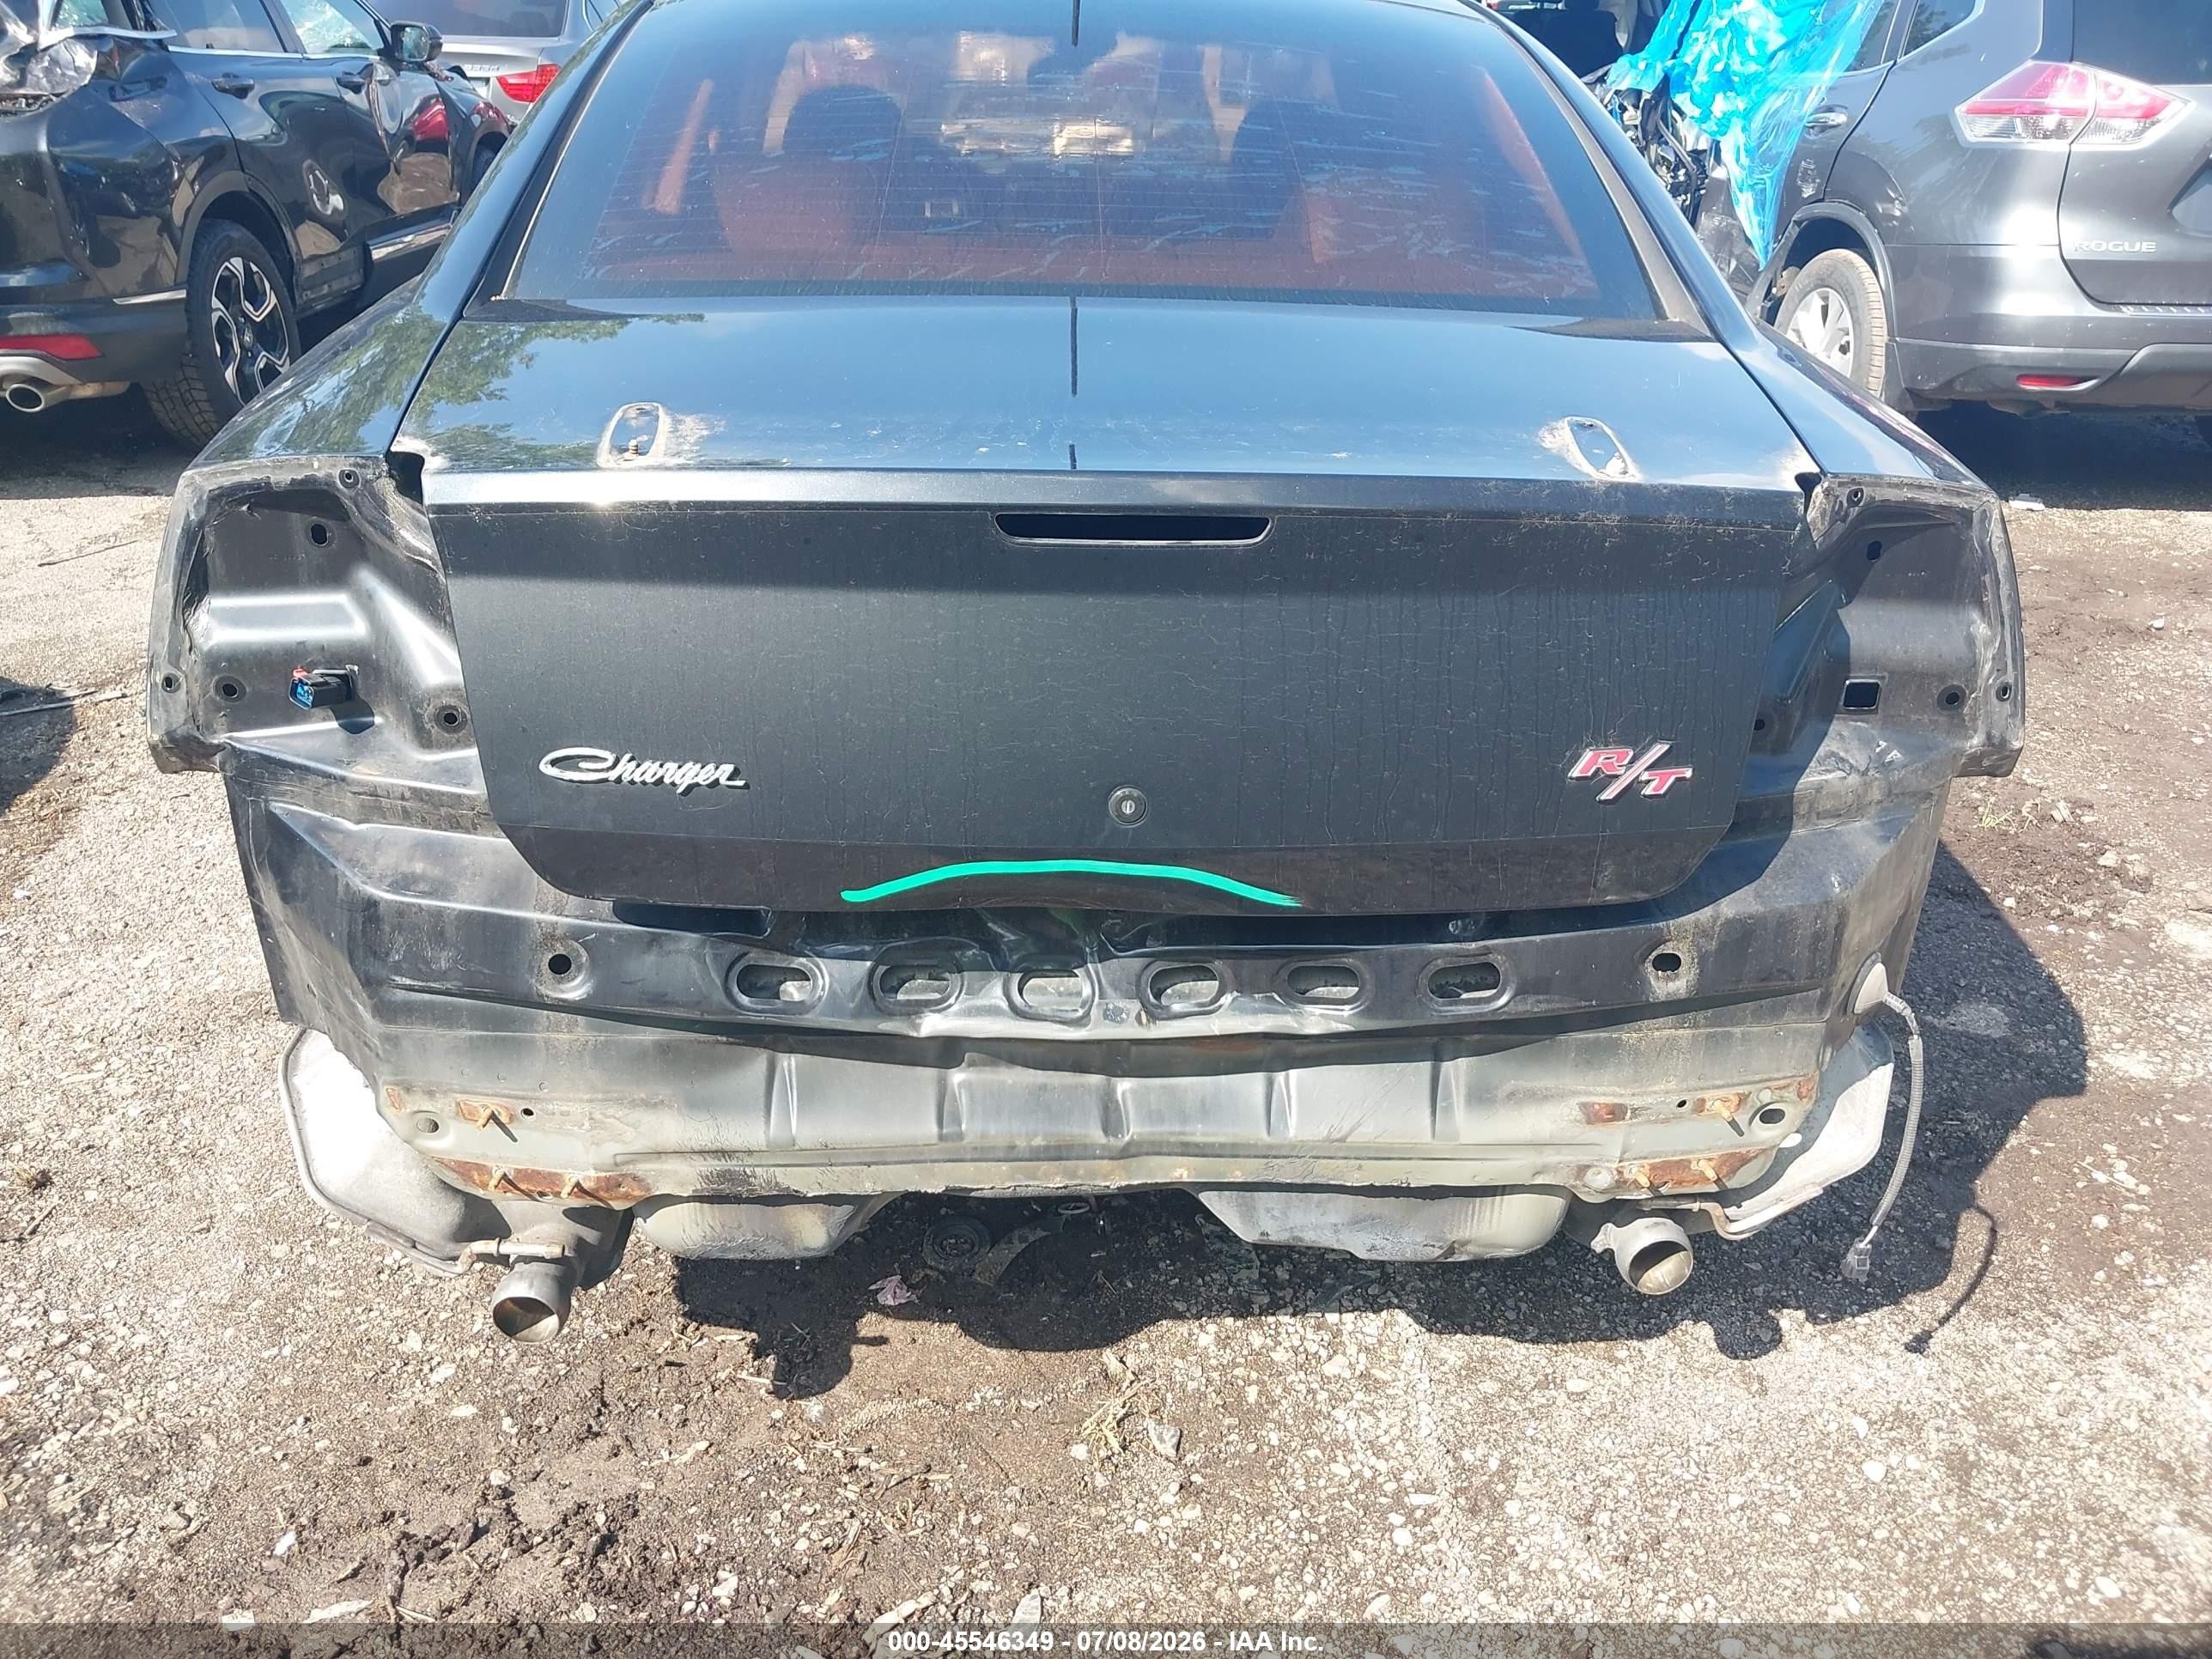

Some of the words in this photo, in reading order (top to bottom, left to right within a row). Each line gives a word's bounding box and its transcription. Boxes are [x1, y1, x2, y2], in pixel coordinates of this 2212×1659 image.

[2074, 240, 2158, 253] ROGUE
[538, 746, 748, 796] Charger
[1567, 742, 1694, 804] R/T
